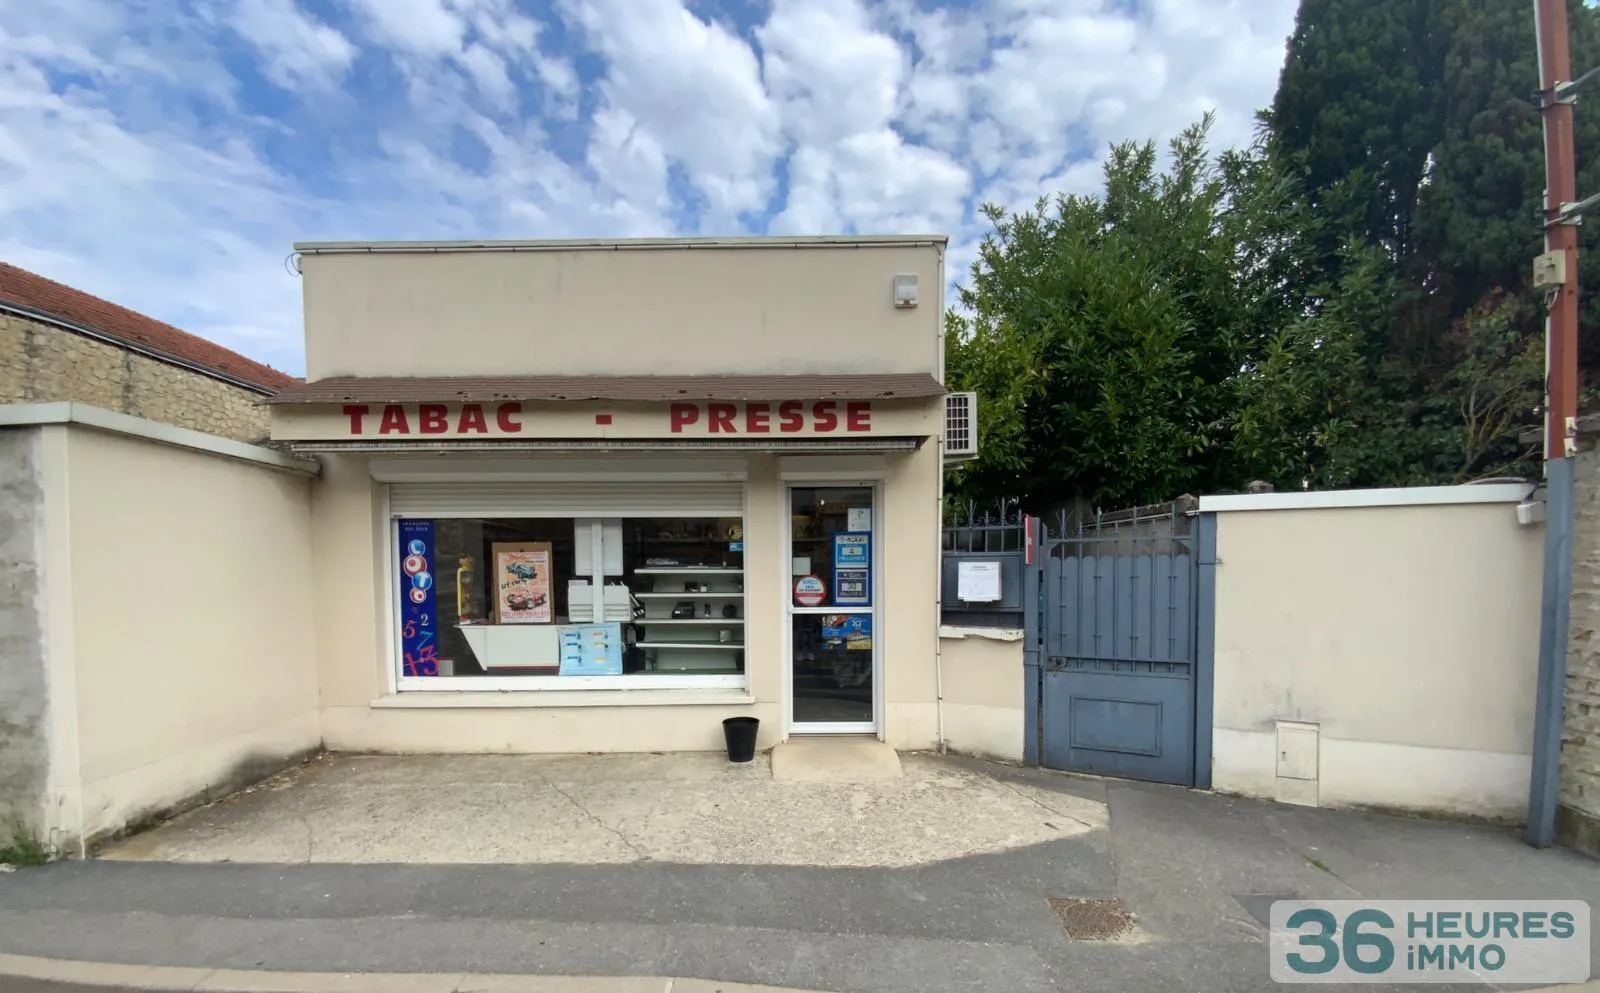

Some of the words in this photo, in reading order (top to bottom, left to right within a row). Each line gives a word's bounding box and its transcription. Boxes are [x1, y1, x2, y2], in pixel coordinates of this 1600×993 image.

[343, 402, 522, 434] TABAC
[670, 401, 872, 433] PRESSE
[405, 540, 431, 602] LOTO
[403, 620, 416, 638] 5
[420, 613, 429, 626] 2
[416, 631, 434, 650] 7
